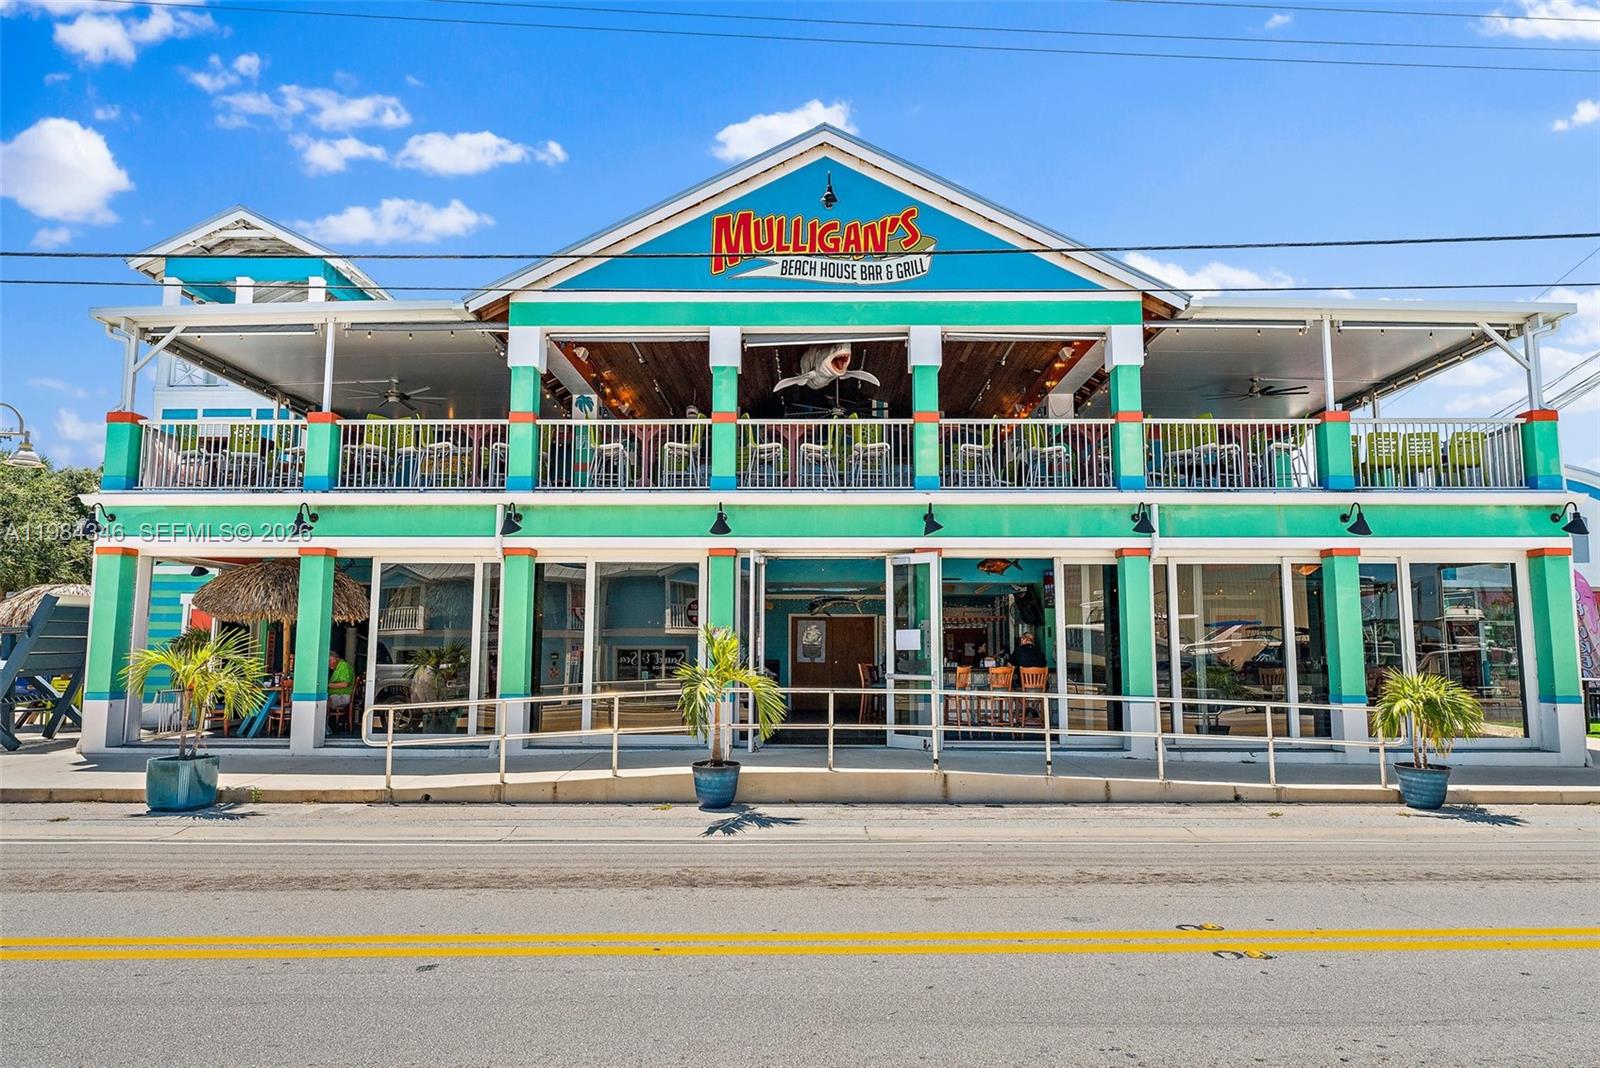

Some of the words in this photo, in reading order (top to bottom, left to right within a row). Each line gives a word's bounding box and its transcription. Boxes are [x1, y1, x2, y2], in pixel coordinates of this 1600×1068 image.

[711, 206, 921, 275] MULLIGAN'S
[780, 259, 817, 276] BEACH
[820, 262, 857, 280] HOUSE
[860, 265, 883, 281] BAR
[886, 265, 893, 280] &
[896, 257, 927, 279] GRILL
